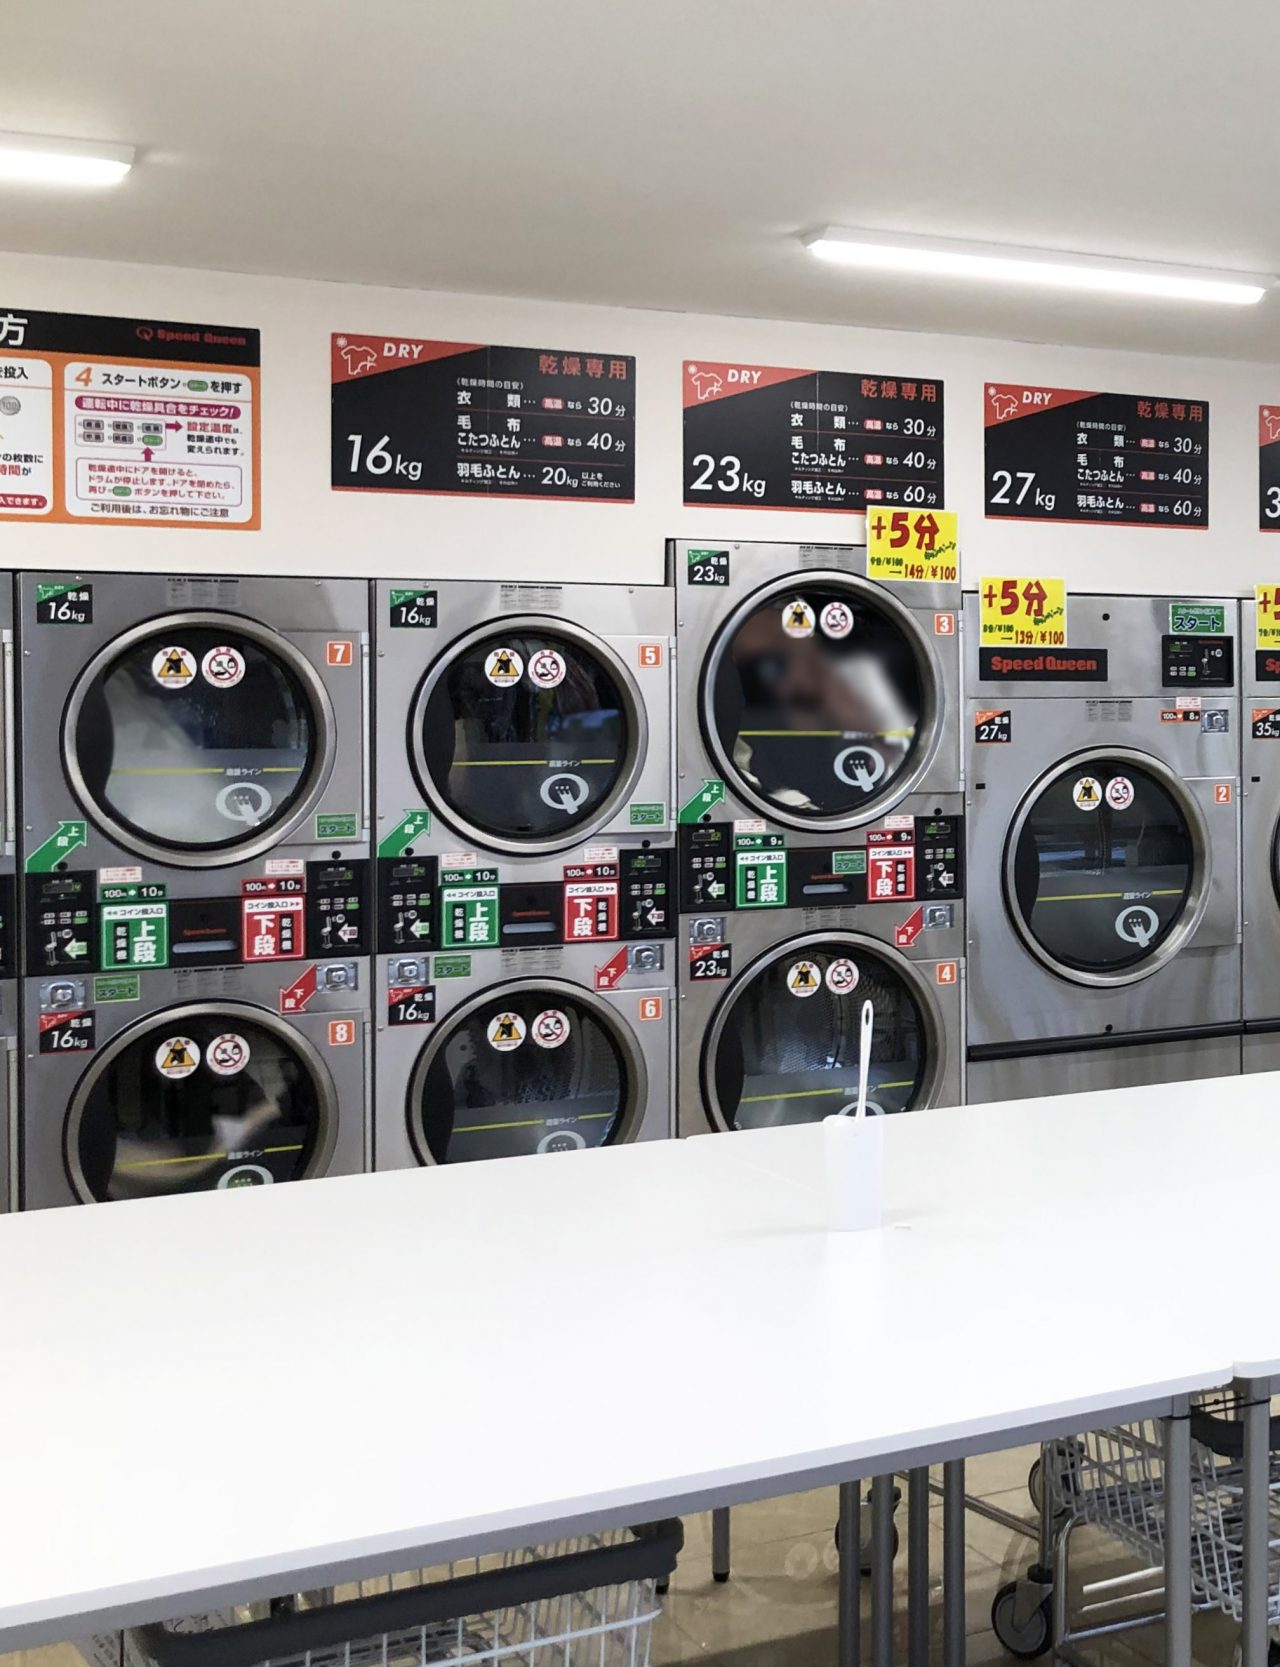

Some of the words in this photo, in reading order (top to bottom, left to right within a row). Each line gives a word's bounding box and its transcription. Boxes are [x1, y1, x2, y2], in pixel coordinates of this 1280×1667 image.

[0, 314, 28, 346] 方
[383, 343, 424, 359] DRY
[538, 354, 626, 379] 乾燥専用
[75, 367, 92, 386] 4
[727, 369, 761, 384] DRY
[860, 379, 936, 402] 乾燥専用
[1023, 391, 1052, 405] DRY
[1138, 401, 1202, 422] 乾燥専用
[457, 432, 520, 448] こたつふとん
[347, 434, 422, 480] 16kg
[791, 452, 846, 468] こたつふとん
[457, 462, 520, 480] 羽毛ふとん
[542, 467, 578, 488] 20kg
[690, 454, 766, 497] 23kg
[1077, 469, 1124, 482] こたつふとん
[791, 481, 846, 496] 羽毛ふとん
[991, 471, 1056, 510] 27kg
[1077, 495, 1124, 509] 羽毛ふとん
[693, 566, 725, 583] 23kg
[48, 602, 85, 622] 16kg
[400, 608, 431, 625] 16kg
[940, 617, 949, 632] 3
[1174, 616, 1221, 631] スタート
[333, 645, 345, 662] 7
[646, 647, 655, 663] 5
[992, 657, 1044, 673] Speed
[1046, 657, 1097, 670] Queen
[980, 726, 1007, 741] 27kg
[1256, 722, 1279, 737] 35kg
[1218, 787, 1228, 801] 2
[632, 813, 662, 822] スタート
[760, 866, 778, 902] 上段
[876, 862, 893, 896] 下段
[469, 902, 488, 942] 上段
[573, 898, 592, 936] 下段
[133, 921, 157, 963] 上段
[254, 915, 276, 956] 下段
[695, 961, 727, 977] 23kg
[941, 966, 951, 981] 4
[398, 1004, 429, 1021] 16kg
[645, 1001, 656, 1016] 6
[51, 1030, 88, 1048] 16kg
[335, 1024, 348, 1042] 8
